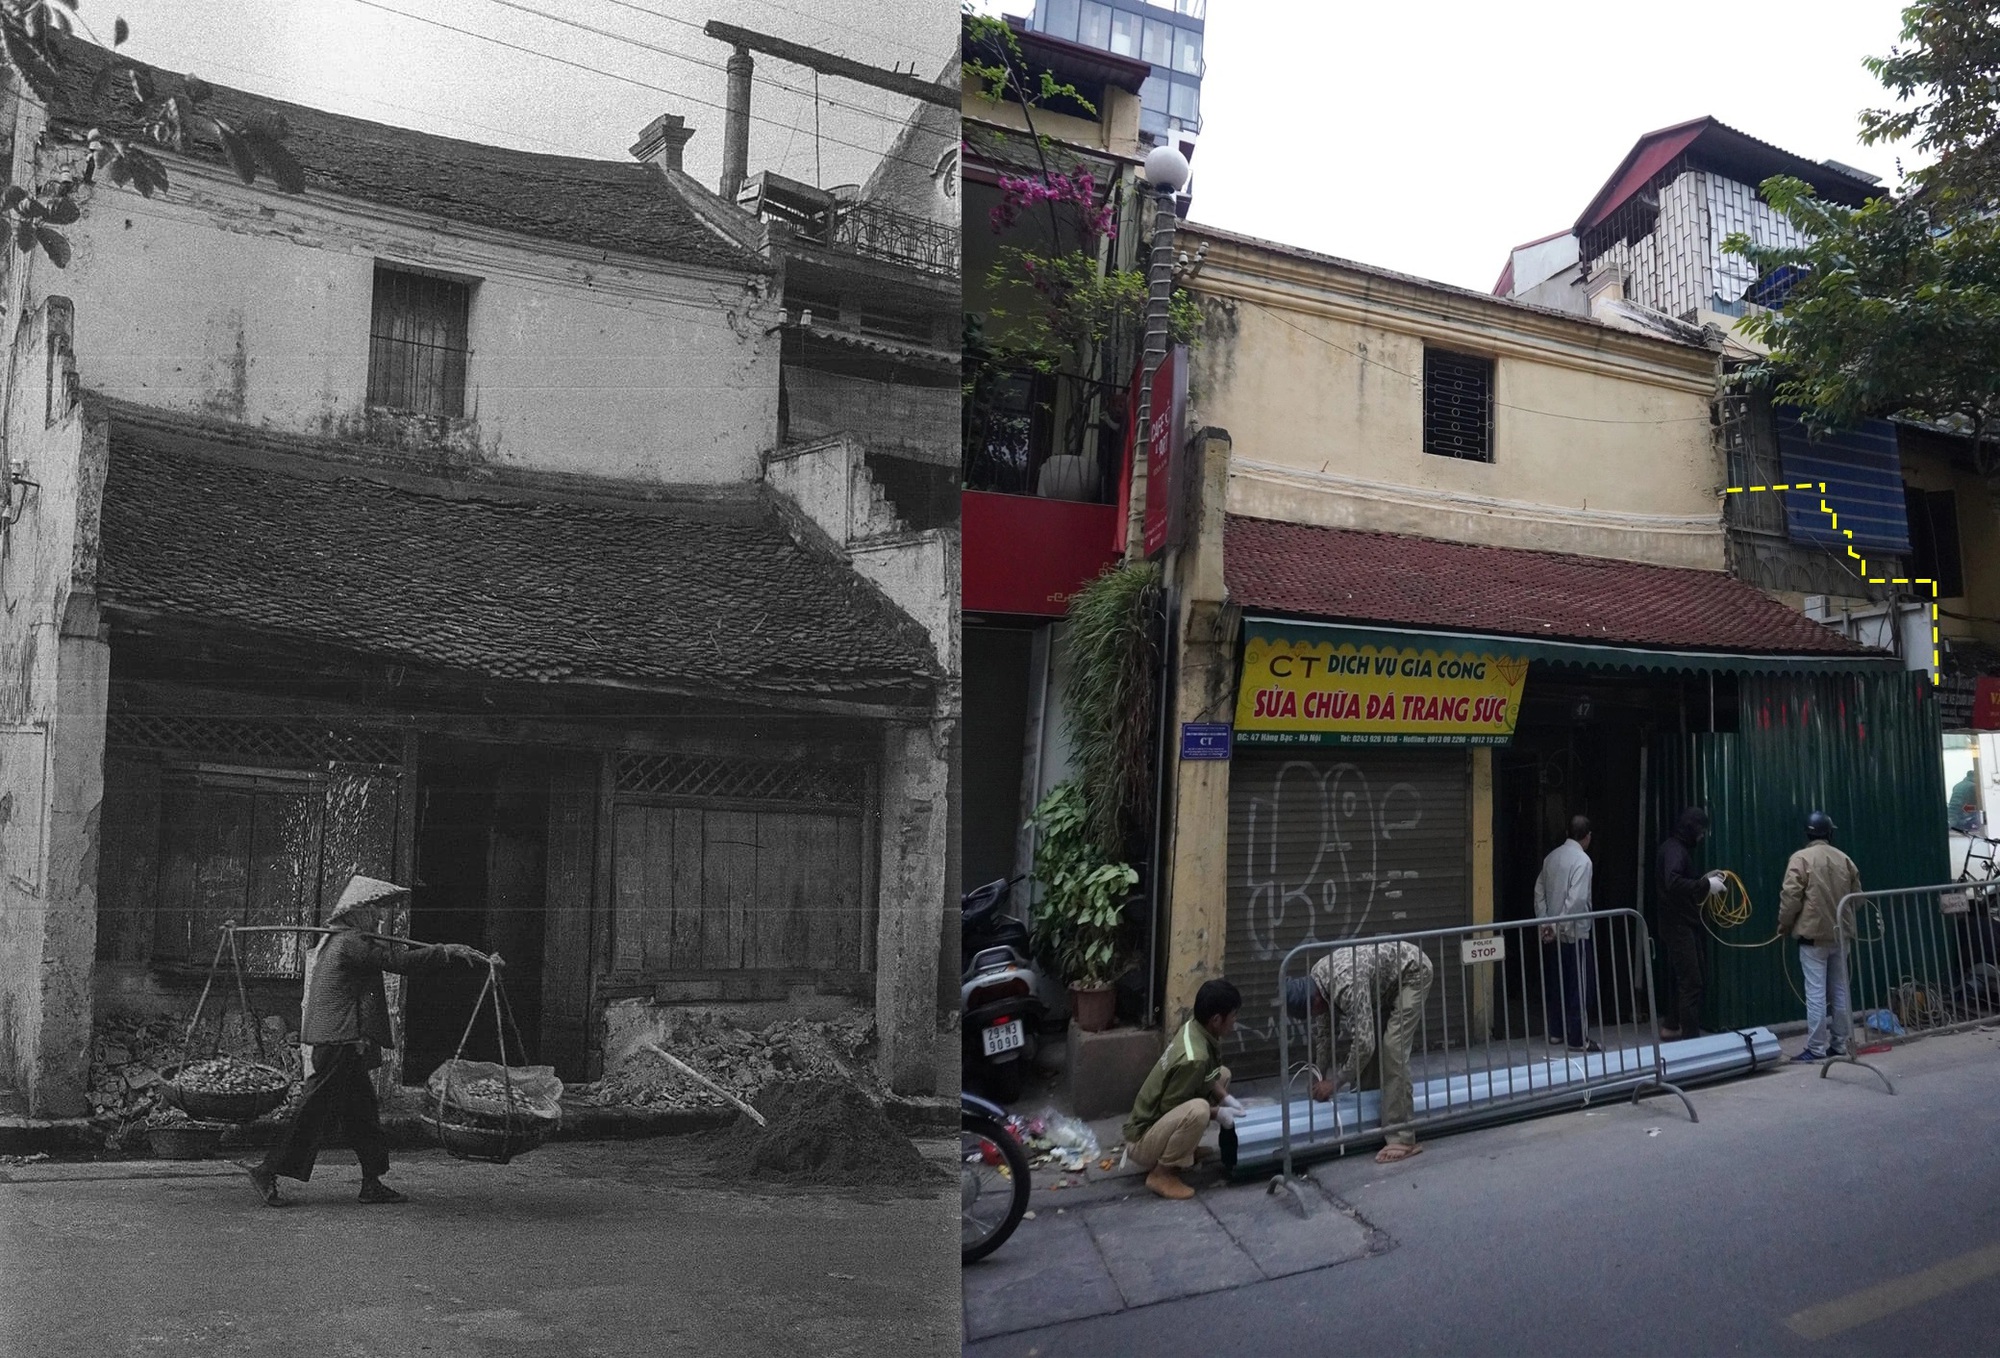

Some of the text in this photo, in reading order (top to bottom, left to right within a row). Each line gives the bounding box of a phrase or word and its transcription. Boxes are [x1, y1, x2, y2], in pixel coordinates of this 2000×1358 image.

[1327, 654, 1370, 676] DỊCH
[1374, 657, 1398, 678] VỤ
[1401, 658, 1432, 677] GIA
[1254, 684, 1507, 722] SỬA CHỮA ĐÁ TRANG SỨC
[1250, 733, 1260, 742] 47
[1261, 733, 1279, 743] Hàng
[1280, 733, 1293, 743] Bạc
[1299, 734, 1309, 742] Hà
[1309, 734, 1322, 744] Nội
[1340, 735, 1351, 743] Tel:
[1403, 735, 1426, 743] Hotline:
[1471, 947, 1496, 958] STOP
[989, 1035, 1019, 1053] 9090
